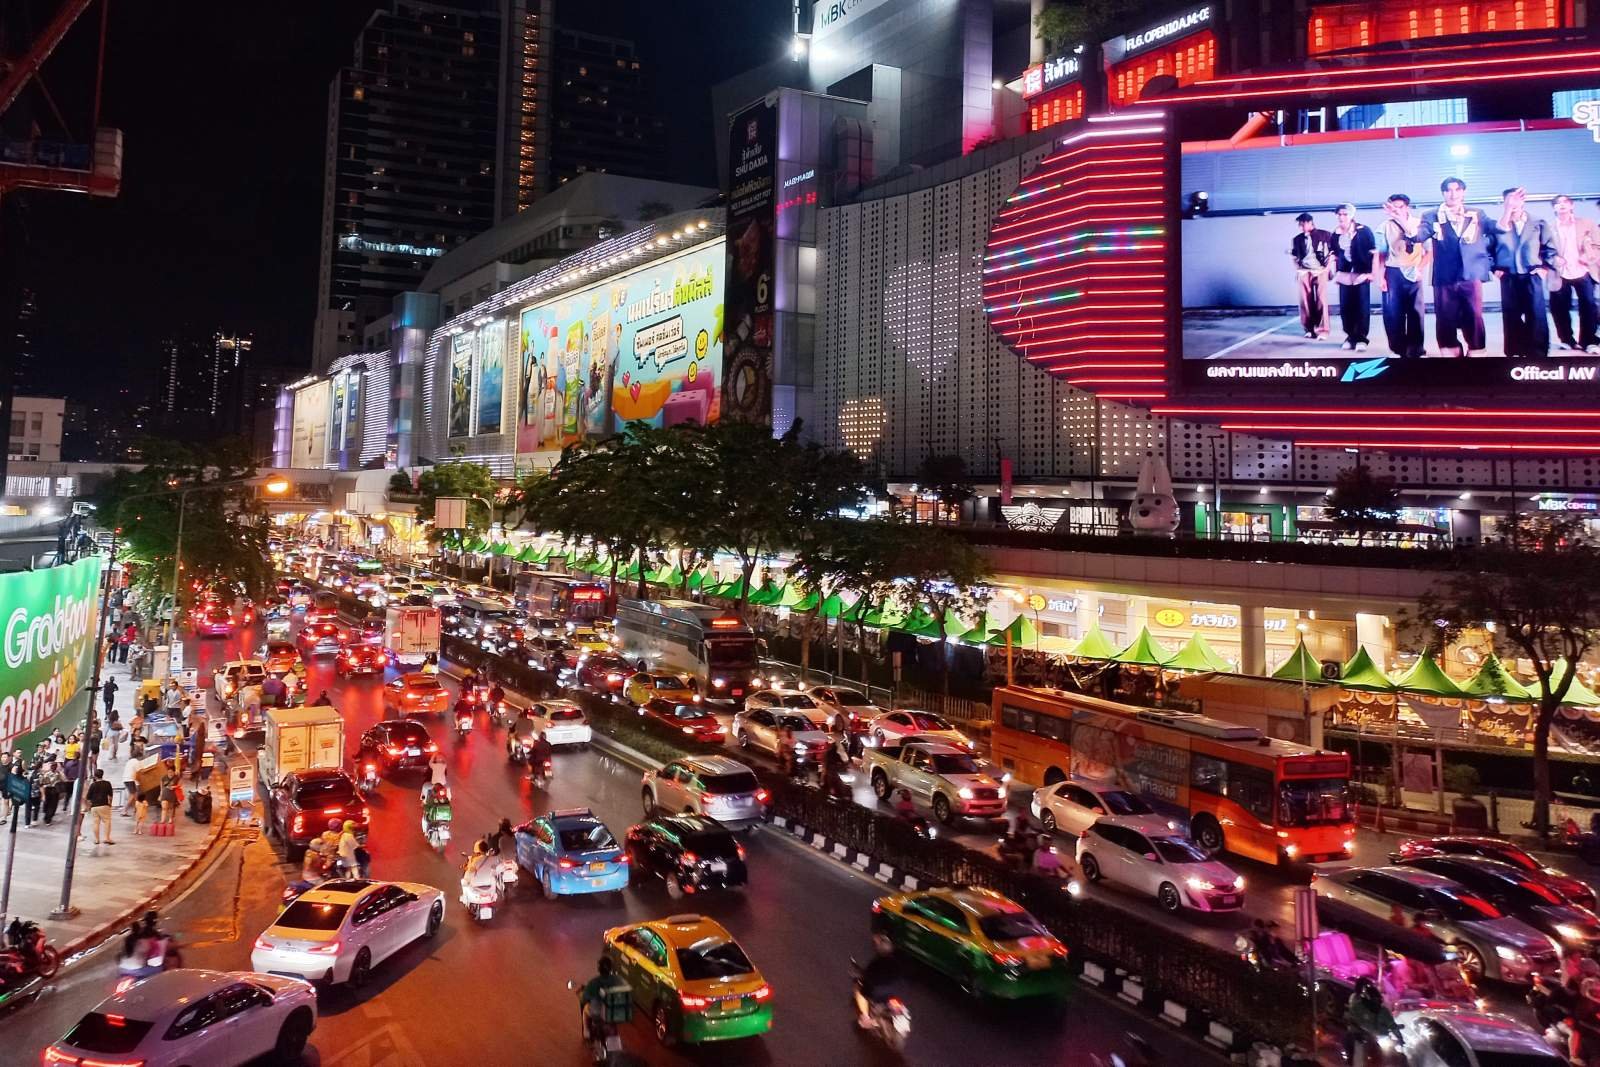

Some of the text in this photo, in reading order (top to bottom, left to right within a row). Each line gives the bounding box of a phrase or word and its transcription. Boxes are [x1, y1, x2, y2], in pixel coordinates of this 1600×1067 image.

[821, 0, 846, 28] MBK
[1207, 361, 1336, 378] ผลงานเพลงใหม่จาก
[1568, 366, 1596, 380] MV
[1538, 499, 1568, 510] MBK
[1070, 506, 1119, 526] BRING THE
[4, 581, 92, 669] GrabFood
